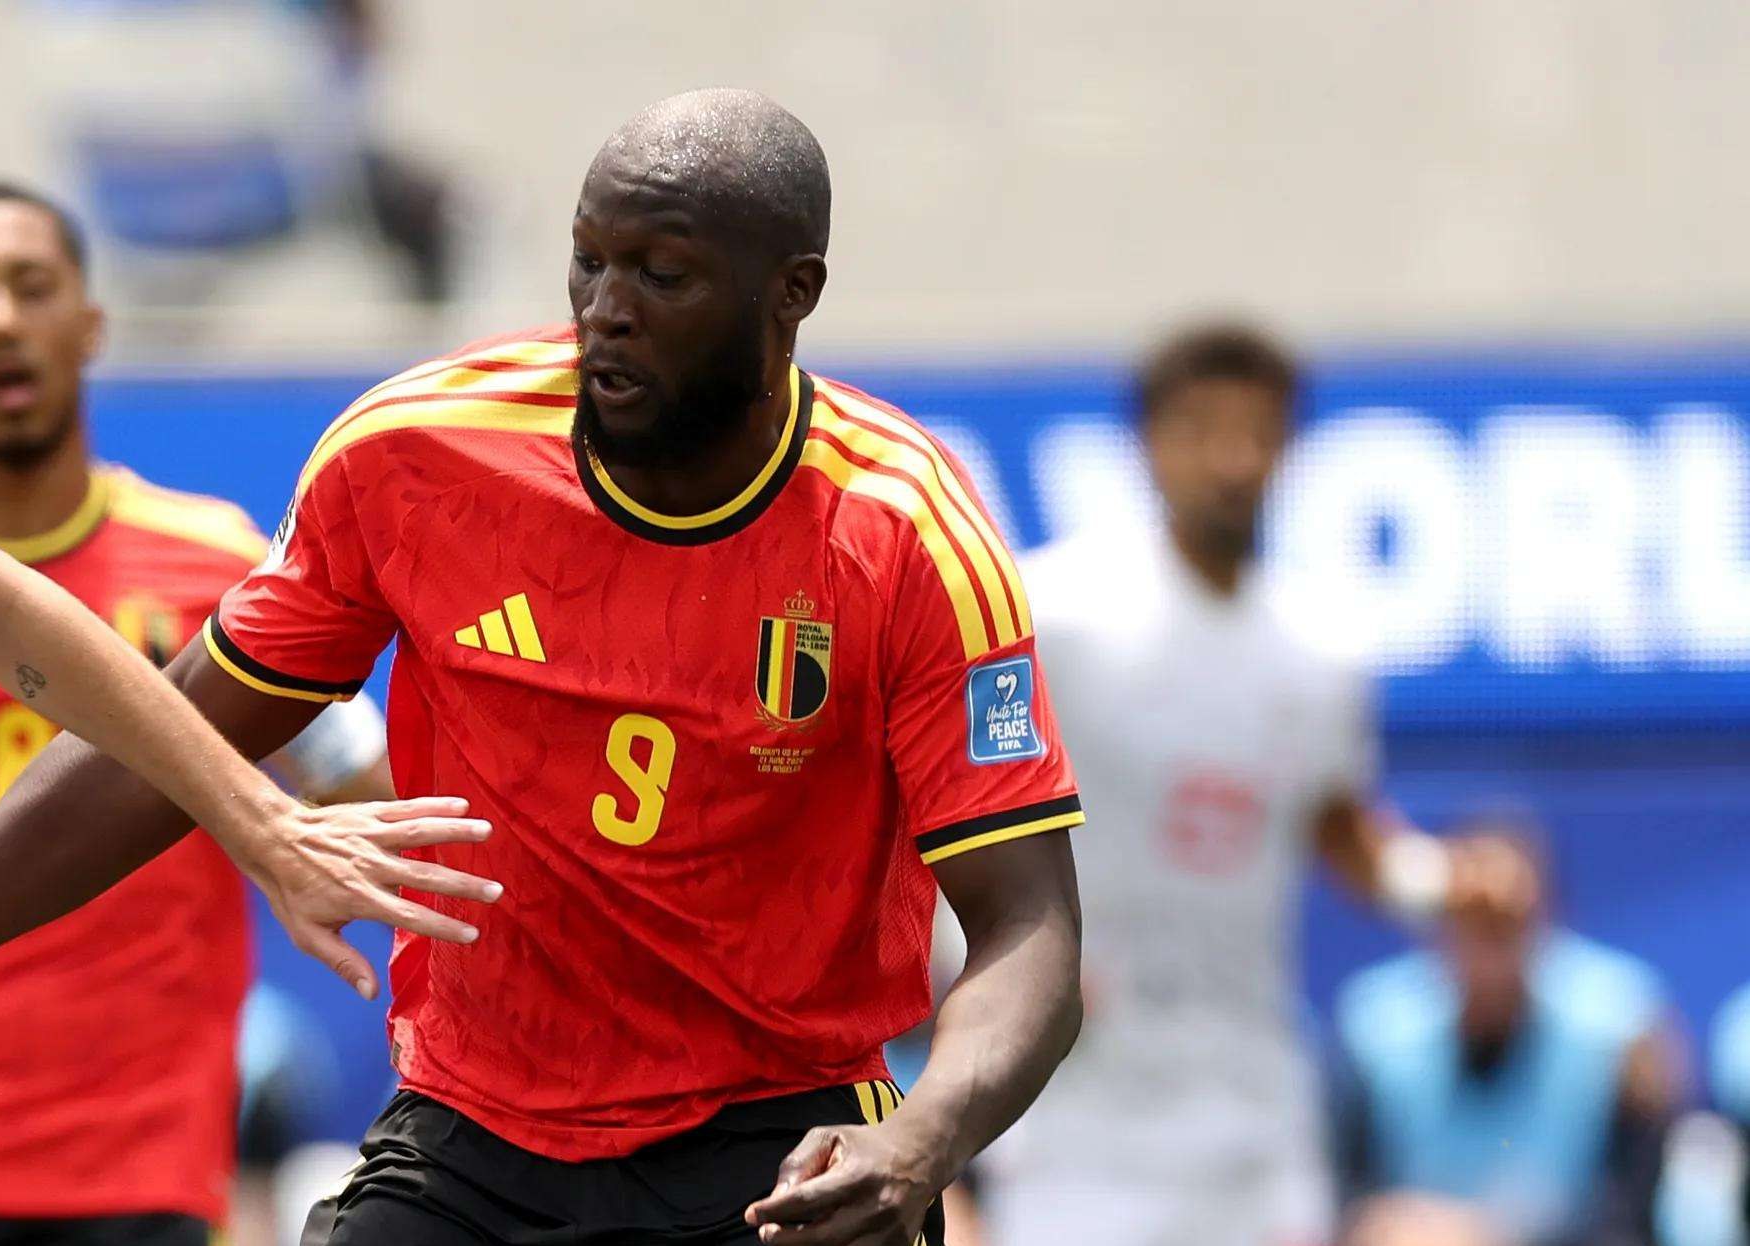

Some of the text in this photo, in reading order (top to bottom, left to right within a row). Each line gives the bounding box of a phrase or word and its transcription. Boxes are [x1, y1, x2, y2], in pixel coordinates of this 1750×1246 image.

[796, 632, 830, 642] BELGIAN
[797, 623, 822, 633] ROYAL
[986, 700, 1028, 723] Unite For
[988, 718, 1028, 741] PEACE
[997, 738, 1022, 752] FIFA
[591, 712, 677, 847] 9
